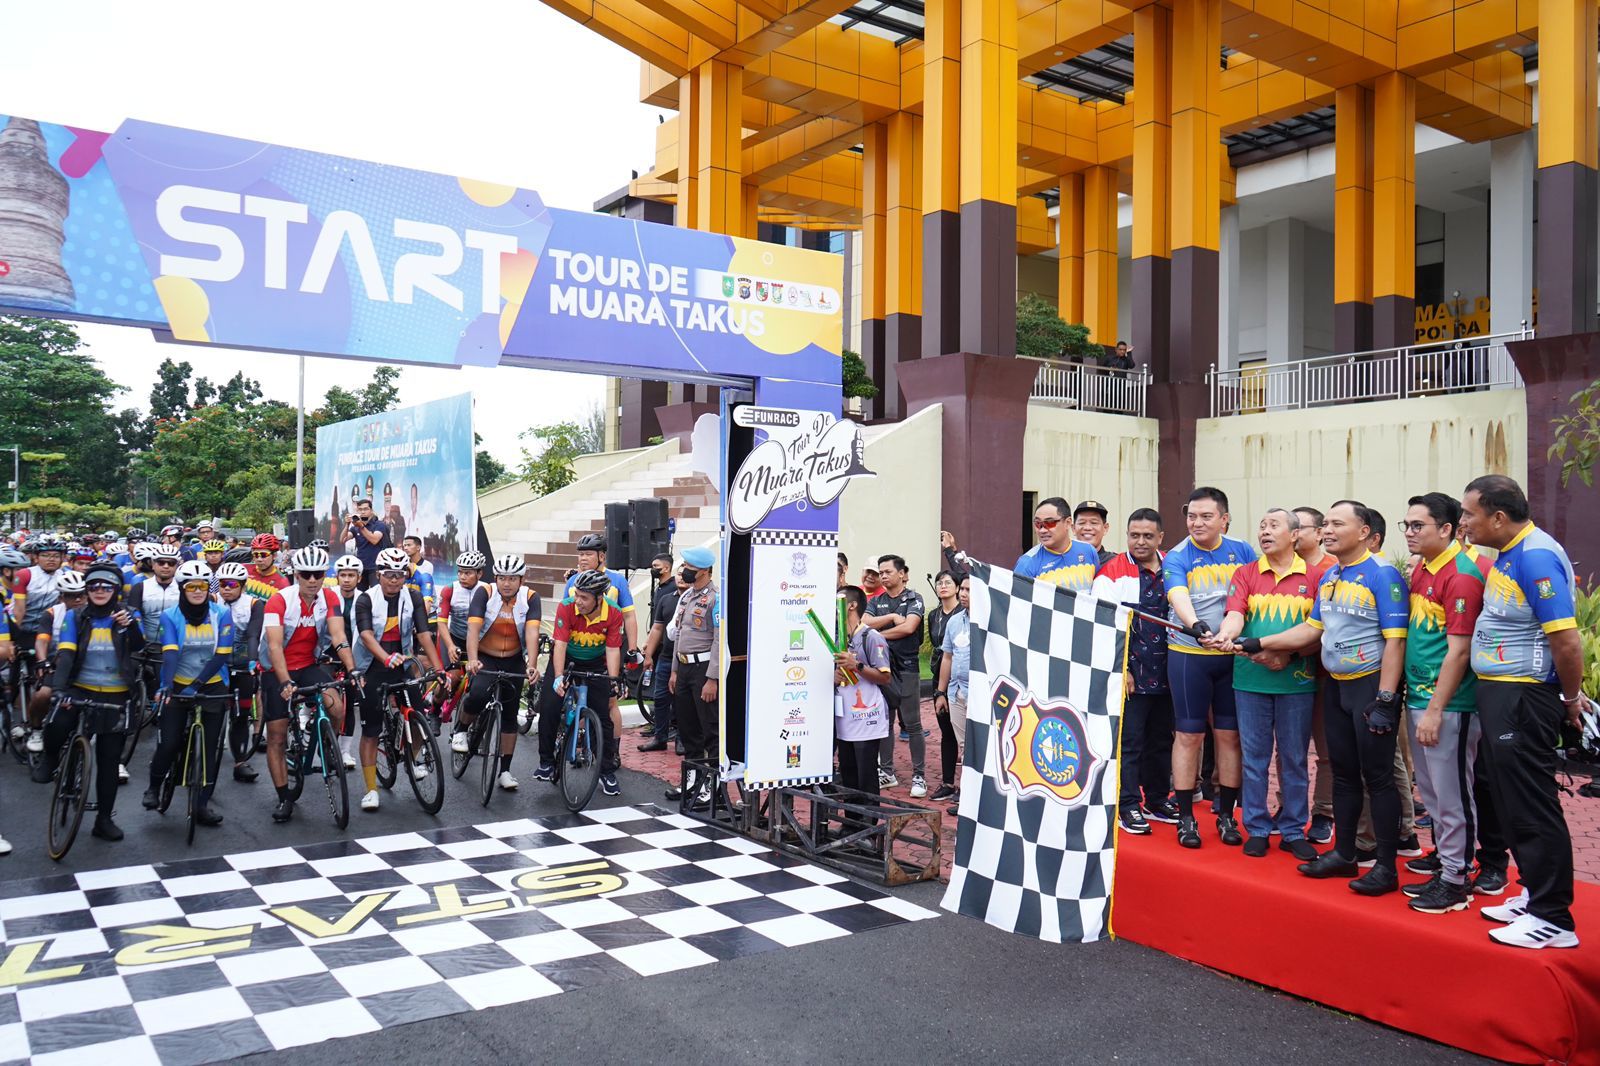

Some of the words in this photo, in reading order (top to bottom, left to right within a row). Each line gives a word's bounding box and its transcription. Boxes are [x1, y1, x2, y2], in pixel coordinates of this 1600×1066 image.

[155, 184, 519, 314] START
[548, 248, 641, 287] TOUR
[648, 263, 689, 296] DE
[549, 284, 666, 327] MUARA
[670, 300, 766, 338] TAKUS
[754, 411, 798, 426] FUNRACE
[788, 433, 811, 461] Tour
[812, 413, 831, 438] De
[365, 447, 380, 462] TOUR
[381, 446, 390, 460] DE
[390, 442, 413, 458] MUARA
[415, 439, 437, 454] TAKUS
[739, 465, 803, 502] Muara
[803, 446, 851, 481] Takus
